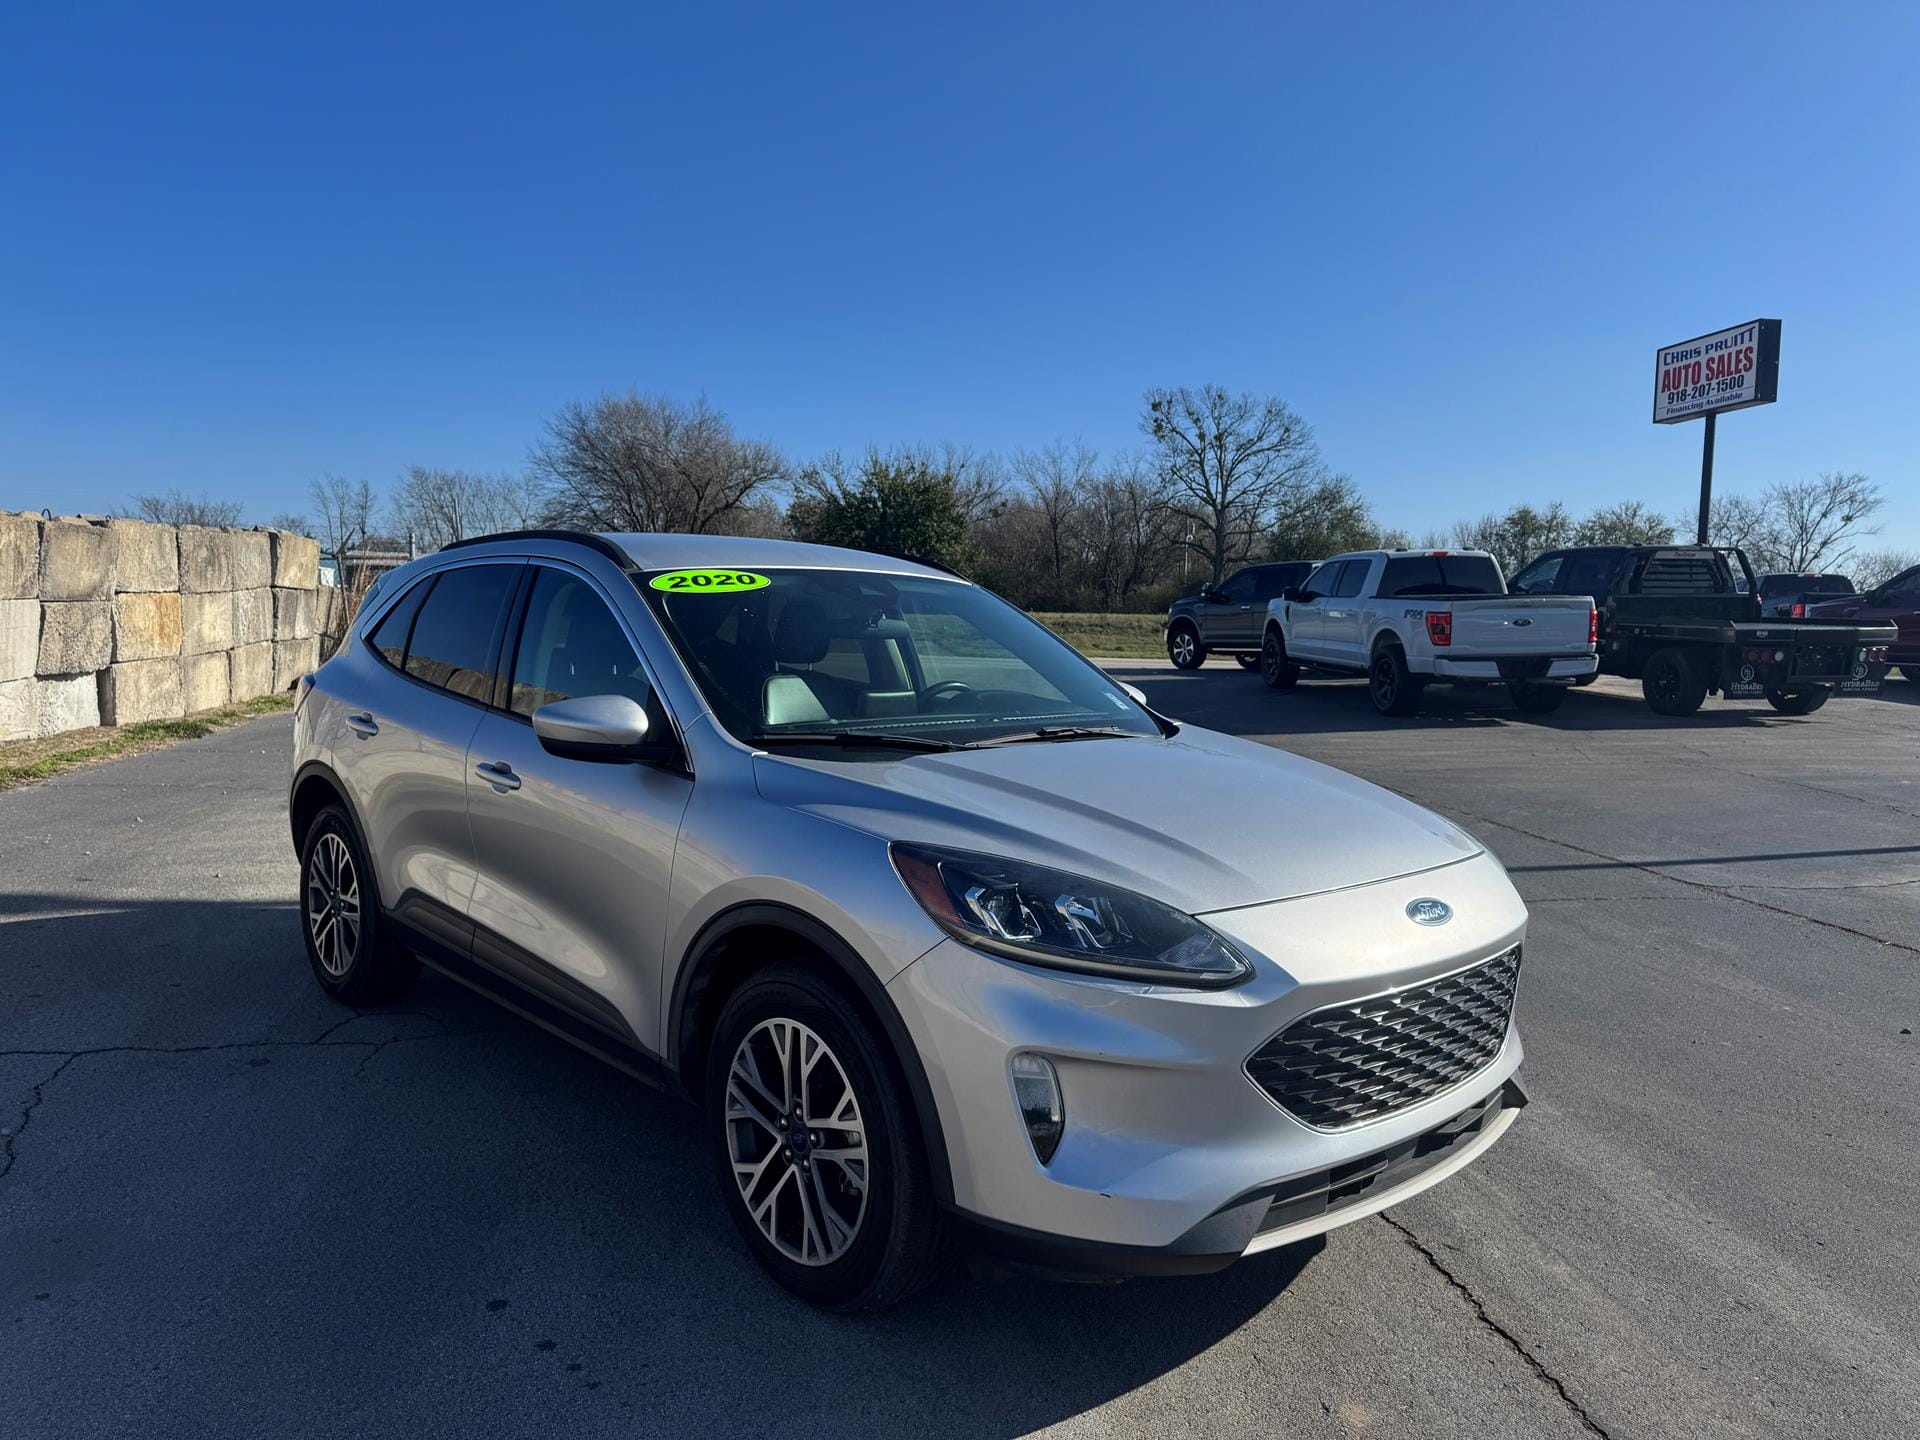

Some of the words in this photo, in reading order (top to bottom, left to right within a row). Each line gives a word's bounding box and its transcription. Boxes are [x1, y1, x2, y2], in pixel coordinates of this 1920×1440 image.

[1664, 347, 1701, 366] CHRIS
[1705, 326, 1755, 355] PRUITT
[1661, 361, 1702, 393] AUTO
[1706, 346, 1754, 381] SALES
[1668, 375, 1744, 405] 918-207-1500
[1667, 401, 1703, 415] Financing
[1705, 392, 1743, 406] Available
[667, 574, 756, 589] 2020
[1416, 902, 1445, 920] Ford
